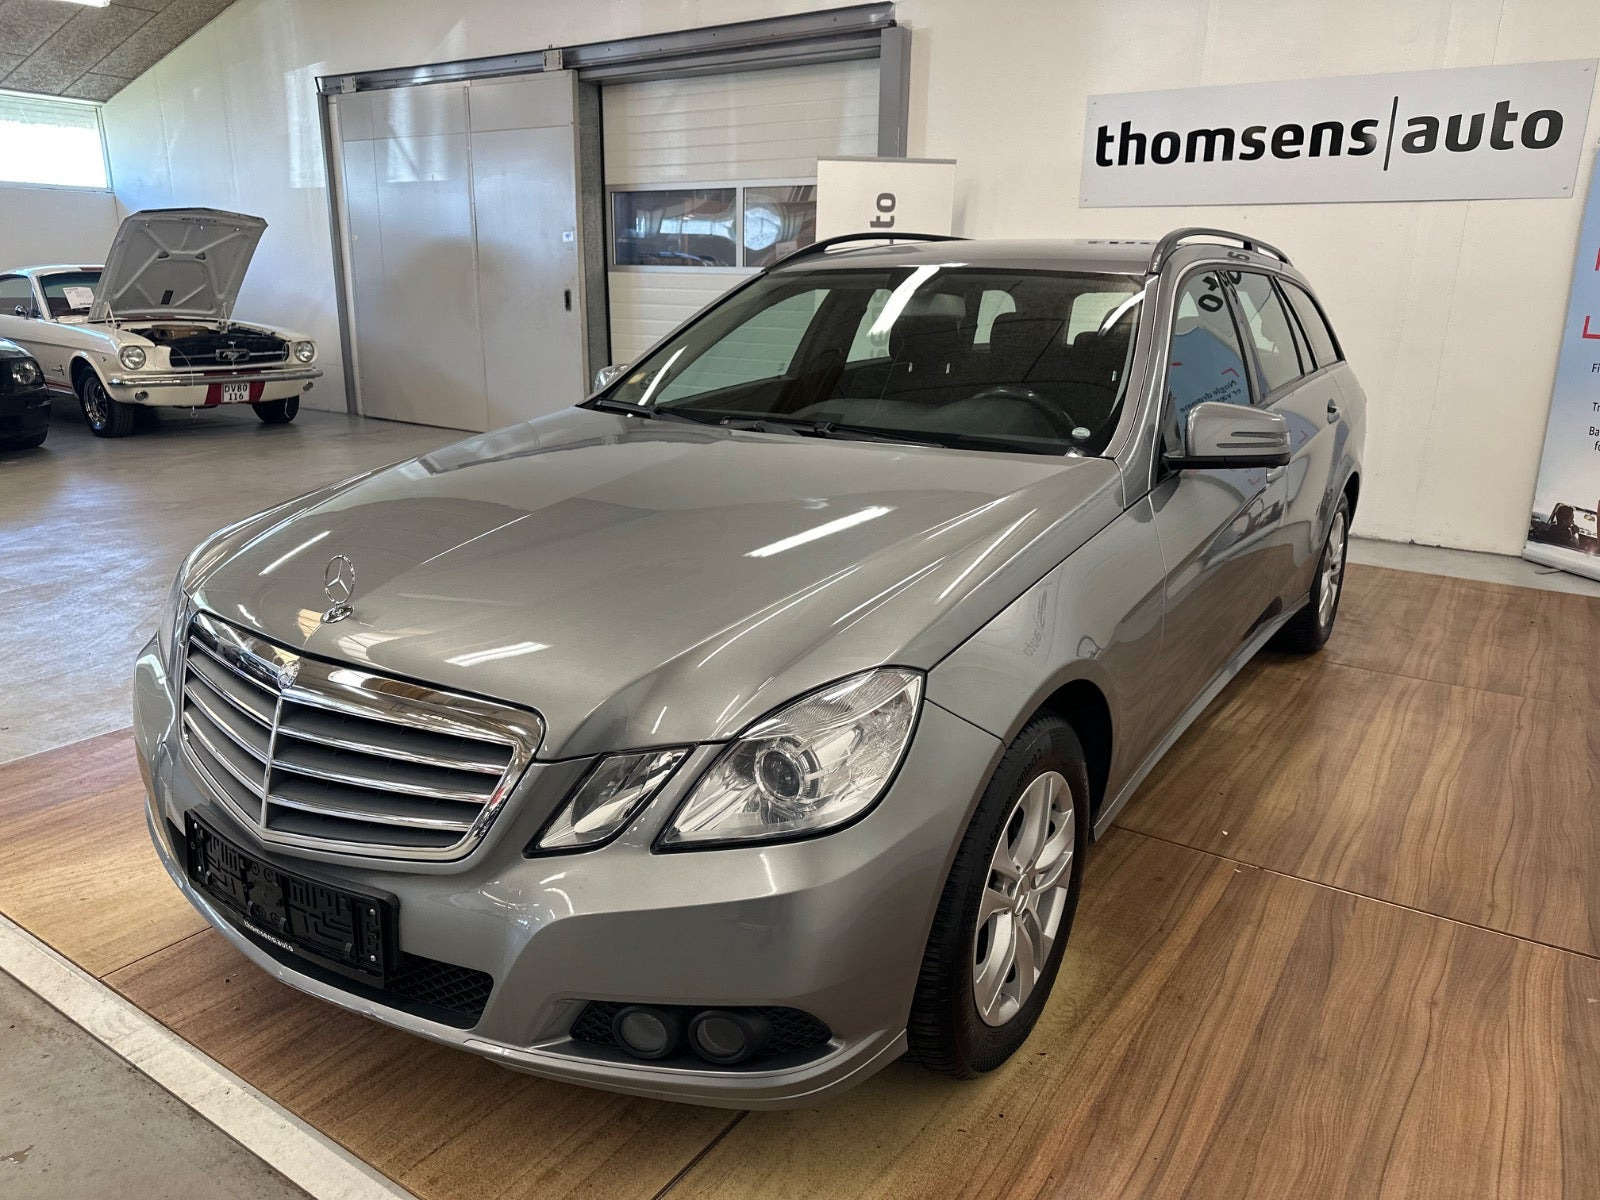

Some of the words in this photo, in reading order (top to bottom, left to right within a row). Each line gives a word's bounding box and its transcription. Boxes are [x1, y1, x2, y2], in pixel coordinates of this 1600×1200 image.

[1096, 118, 1379, 168] thomsens
[1401, 100, 1564, 155] auto
[1592, 363, 1600, 373] Fi
[229, 393, 244, 401] 116
[1592, 402, 1600, 412] Tr
[1589, 426, 1600, 437] Ba
